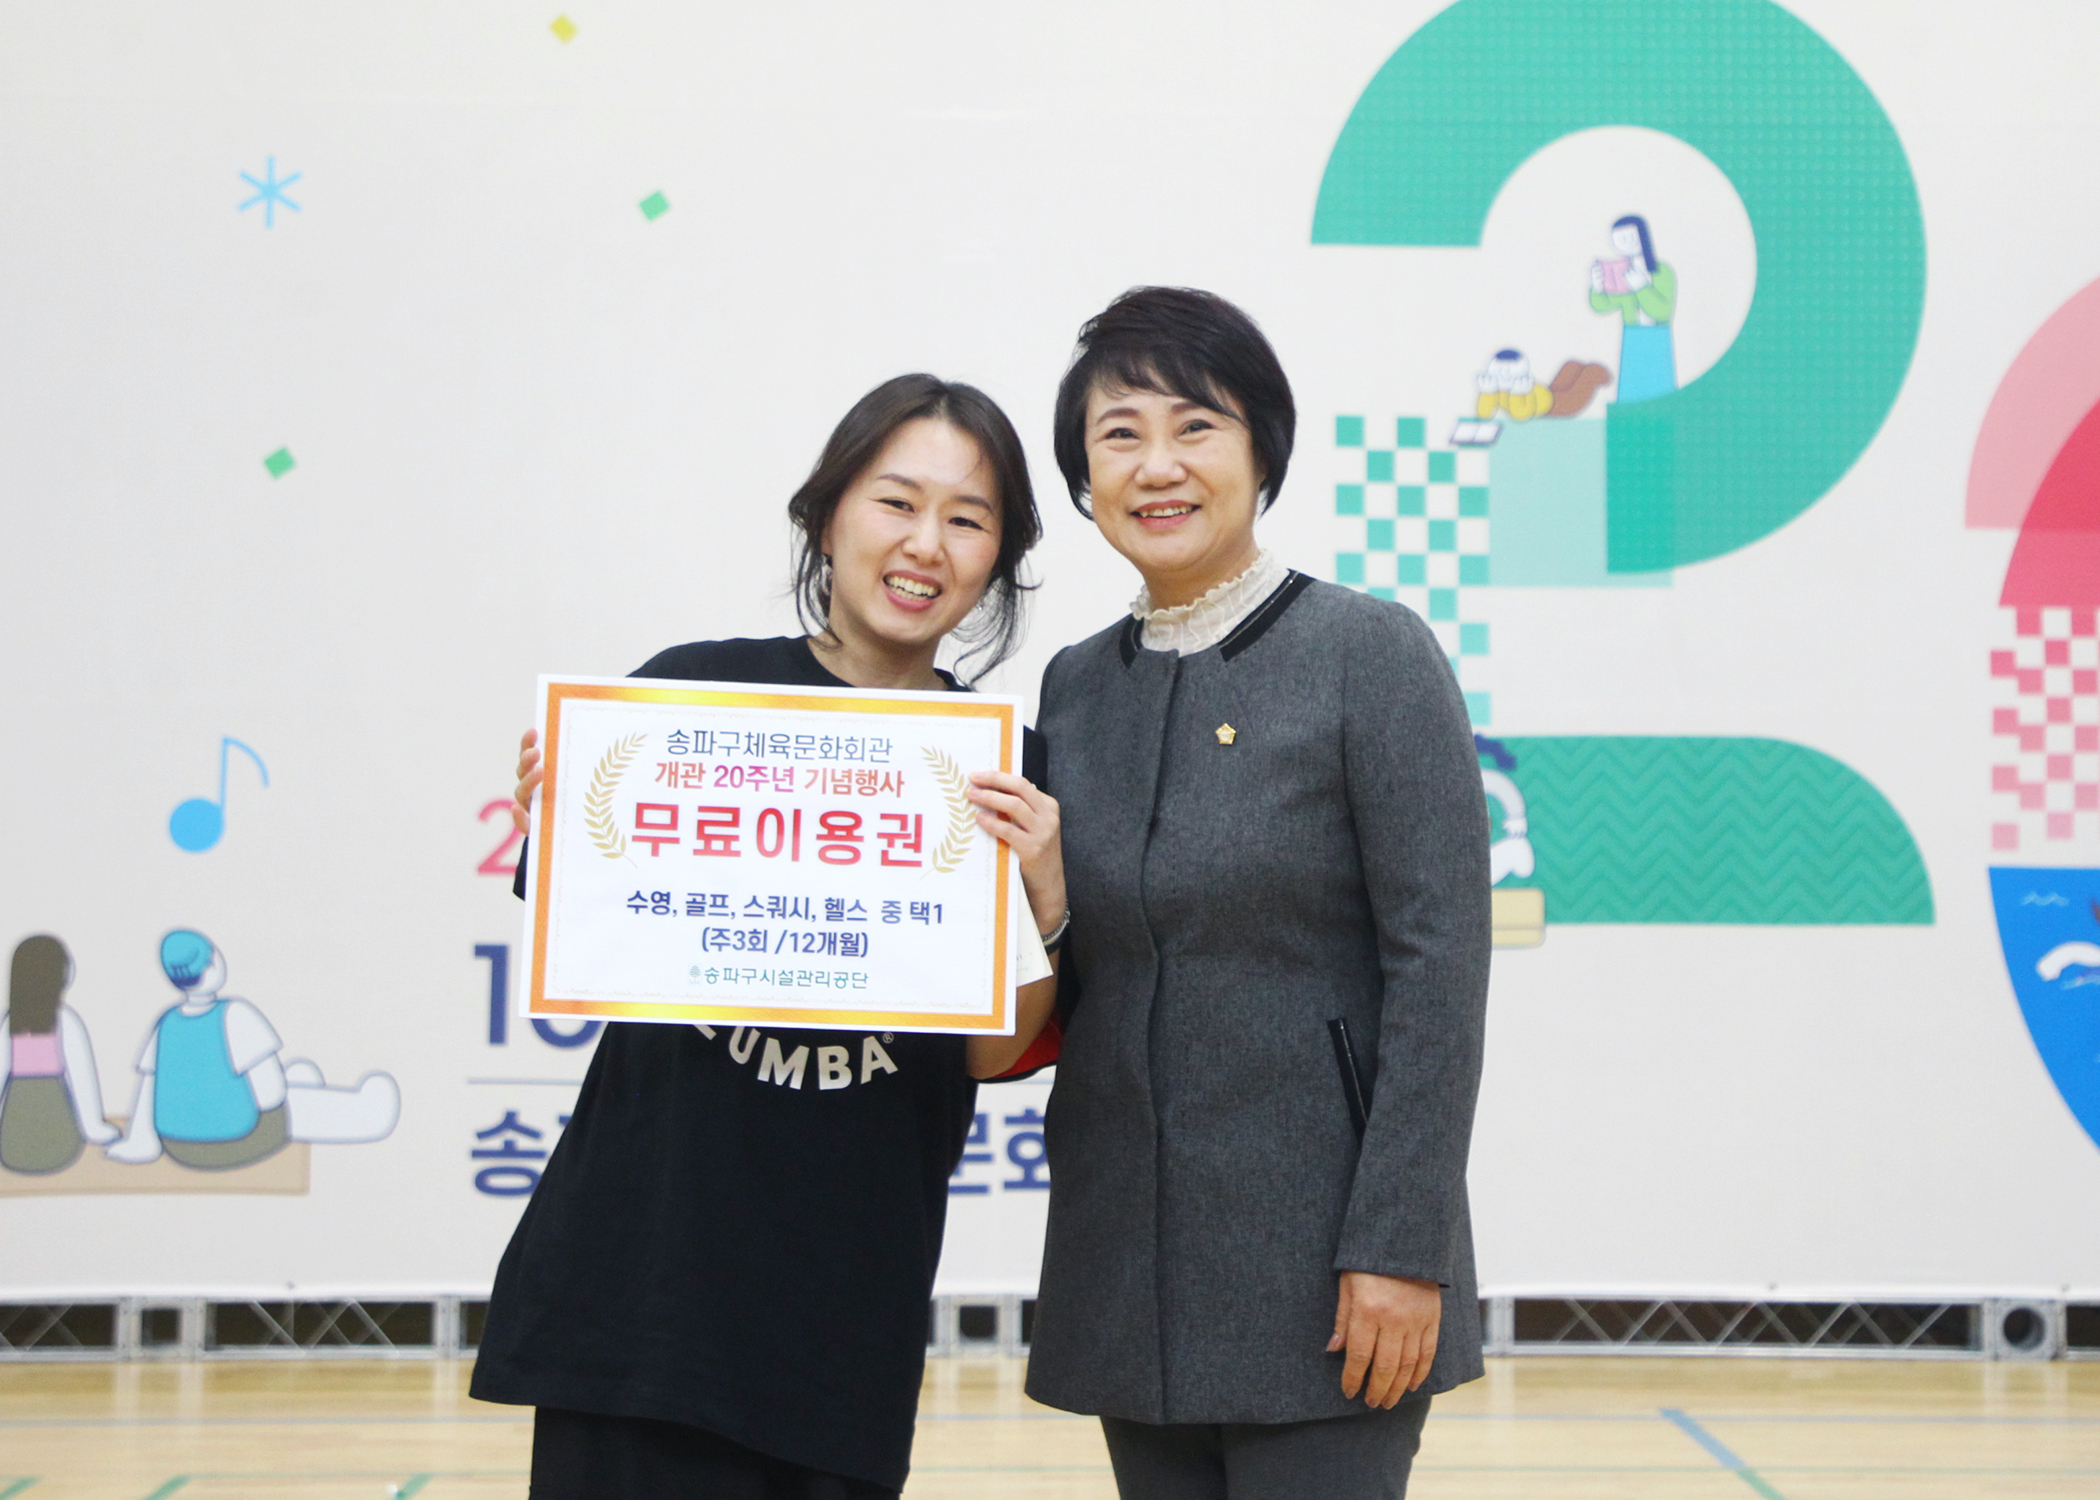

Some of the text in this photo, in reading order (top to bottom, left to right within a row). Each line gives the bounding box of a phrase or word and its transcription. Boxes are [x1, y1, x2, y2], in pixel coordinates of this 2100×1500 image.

[666, 729, 893, 763] 송파구체육문화회관
[655, 761, 905, 798] 개관 20주년 기념행사
[631, 802, 923, 867] 무료이용권
[626, 890, 944, 926] 수영, 골프, 스쿼시, 헬스 중 택1
[701, 926, 870, 958] (주3회 /12개월)
[704, 966, 869, 990] 송파구시설관리공단
